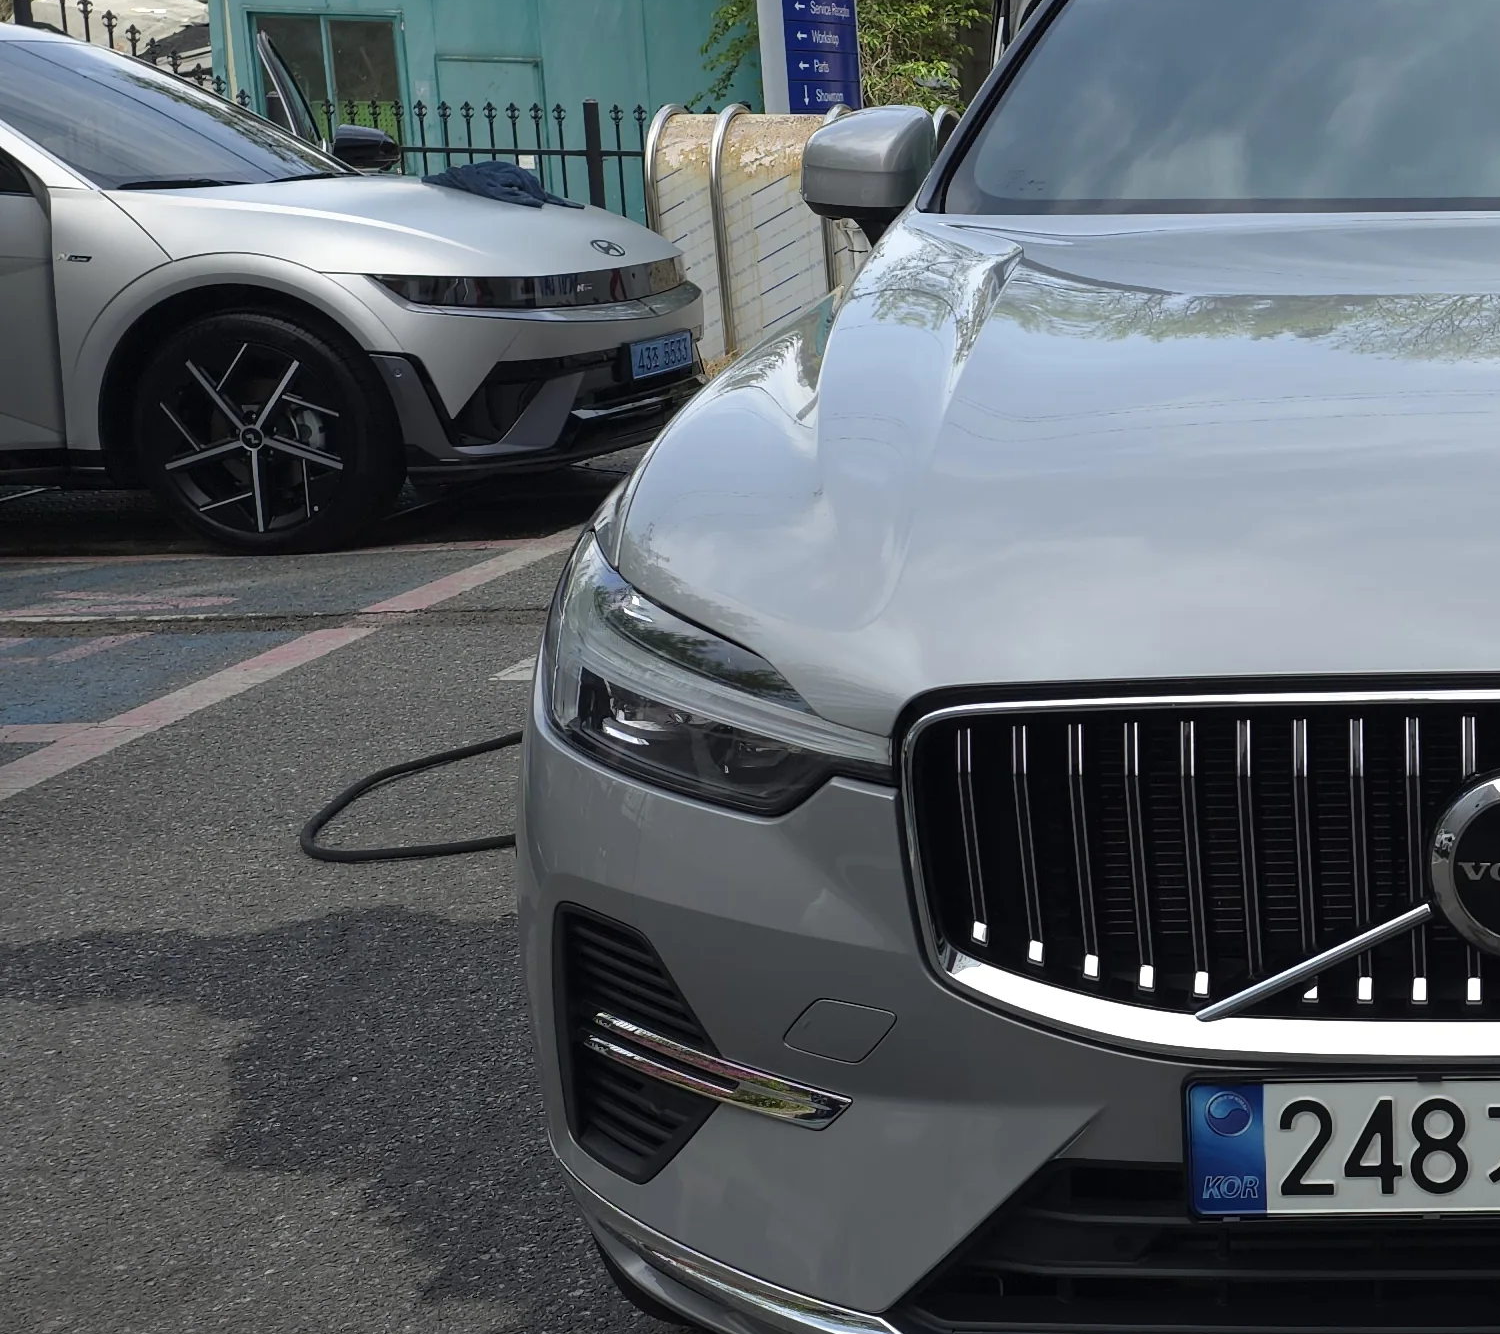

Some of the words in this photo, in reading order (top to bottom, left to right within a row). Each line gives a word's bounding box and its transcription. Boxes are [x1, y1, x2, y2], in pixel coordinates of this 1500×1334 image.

[810, 0, 831, 15] Service
[811, 30, 839, 47] Workshop
[814, 59, 830, 72] Parts
[638, 347, 659, 372] 43조
[664, 337, 687, 365] 5533
[1202, 1175, 1260, 1199] KOR
